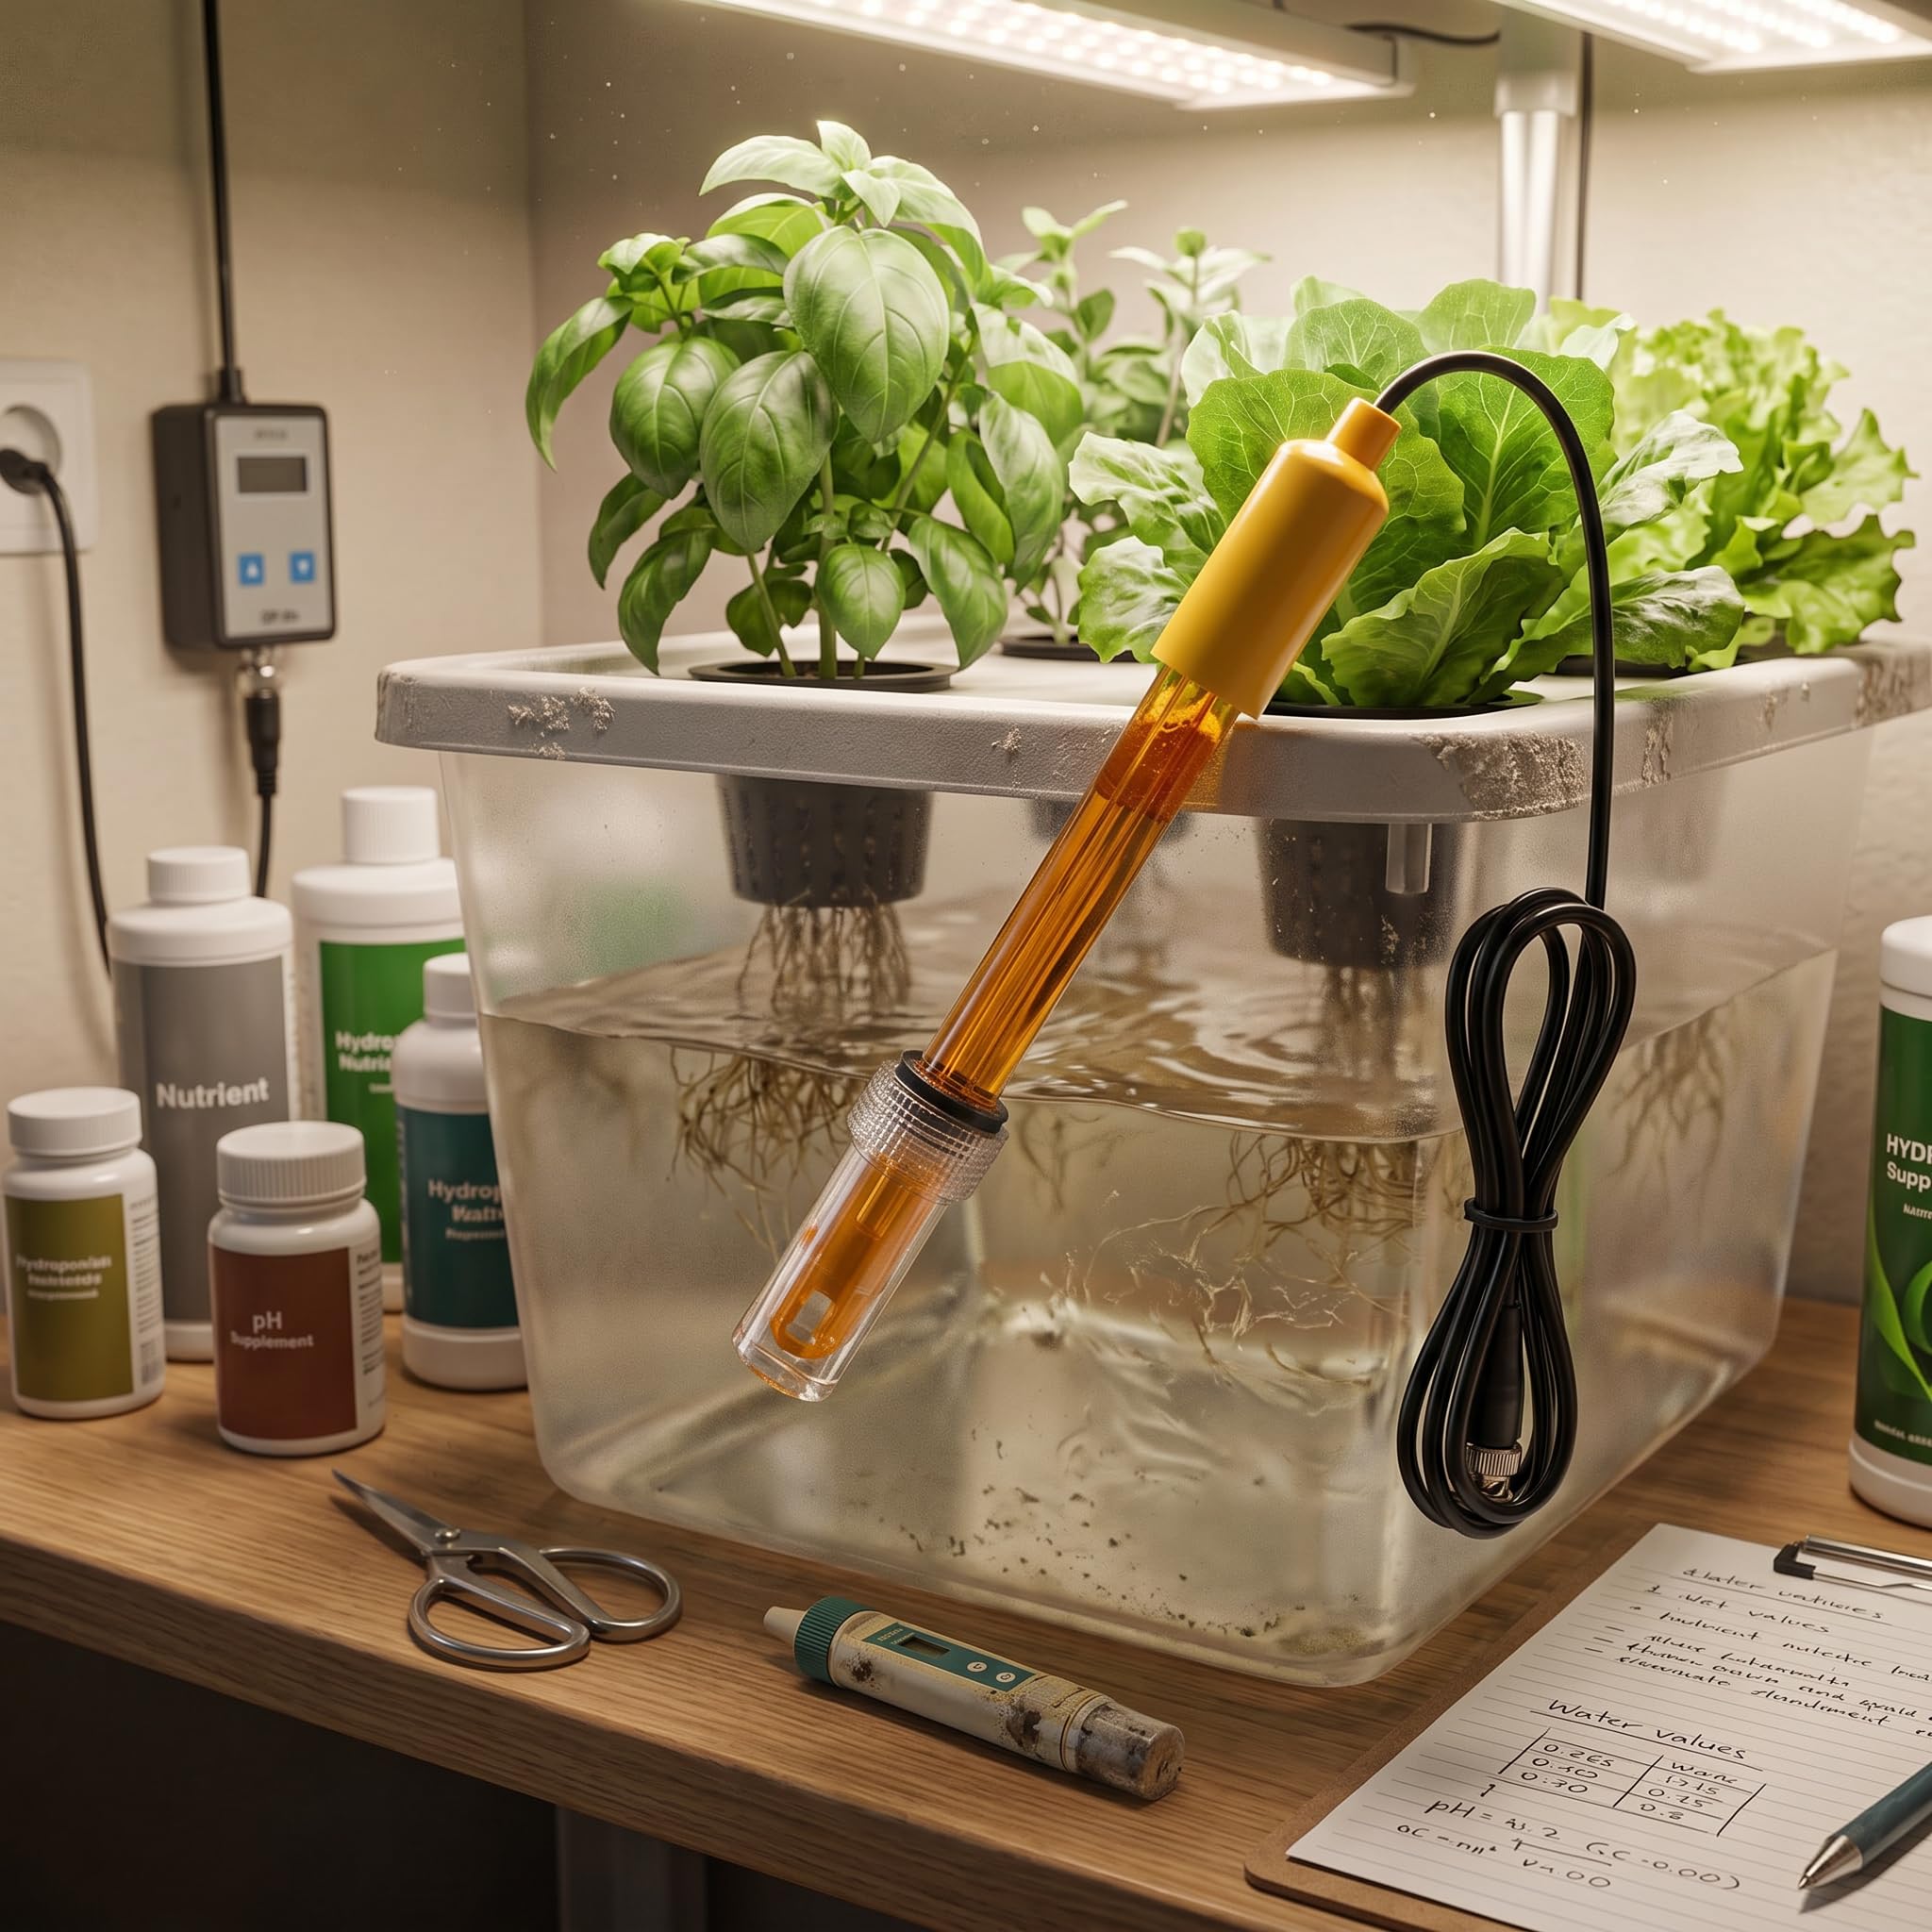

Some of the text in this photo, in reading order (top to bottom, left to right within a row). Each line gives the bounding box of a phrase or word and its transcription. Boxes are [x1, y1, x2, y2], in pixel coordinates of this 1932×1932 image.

[335, 1030, 395, 1055] Hydro
[156, 1076, 270, 1109] Nutrient
[1887, 1160, 1932, 1193] Supp
[252, 1311, 283, 1334] pH
[1548, 1699, 1747, 1761] Water values
[1424, 1799, 1476, 1819] pH
